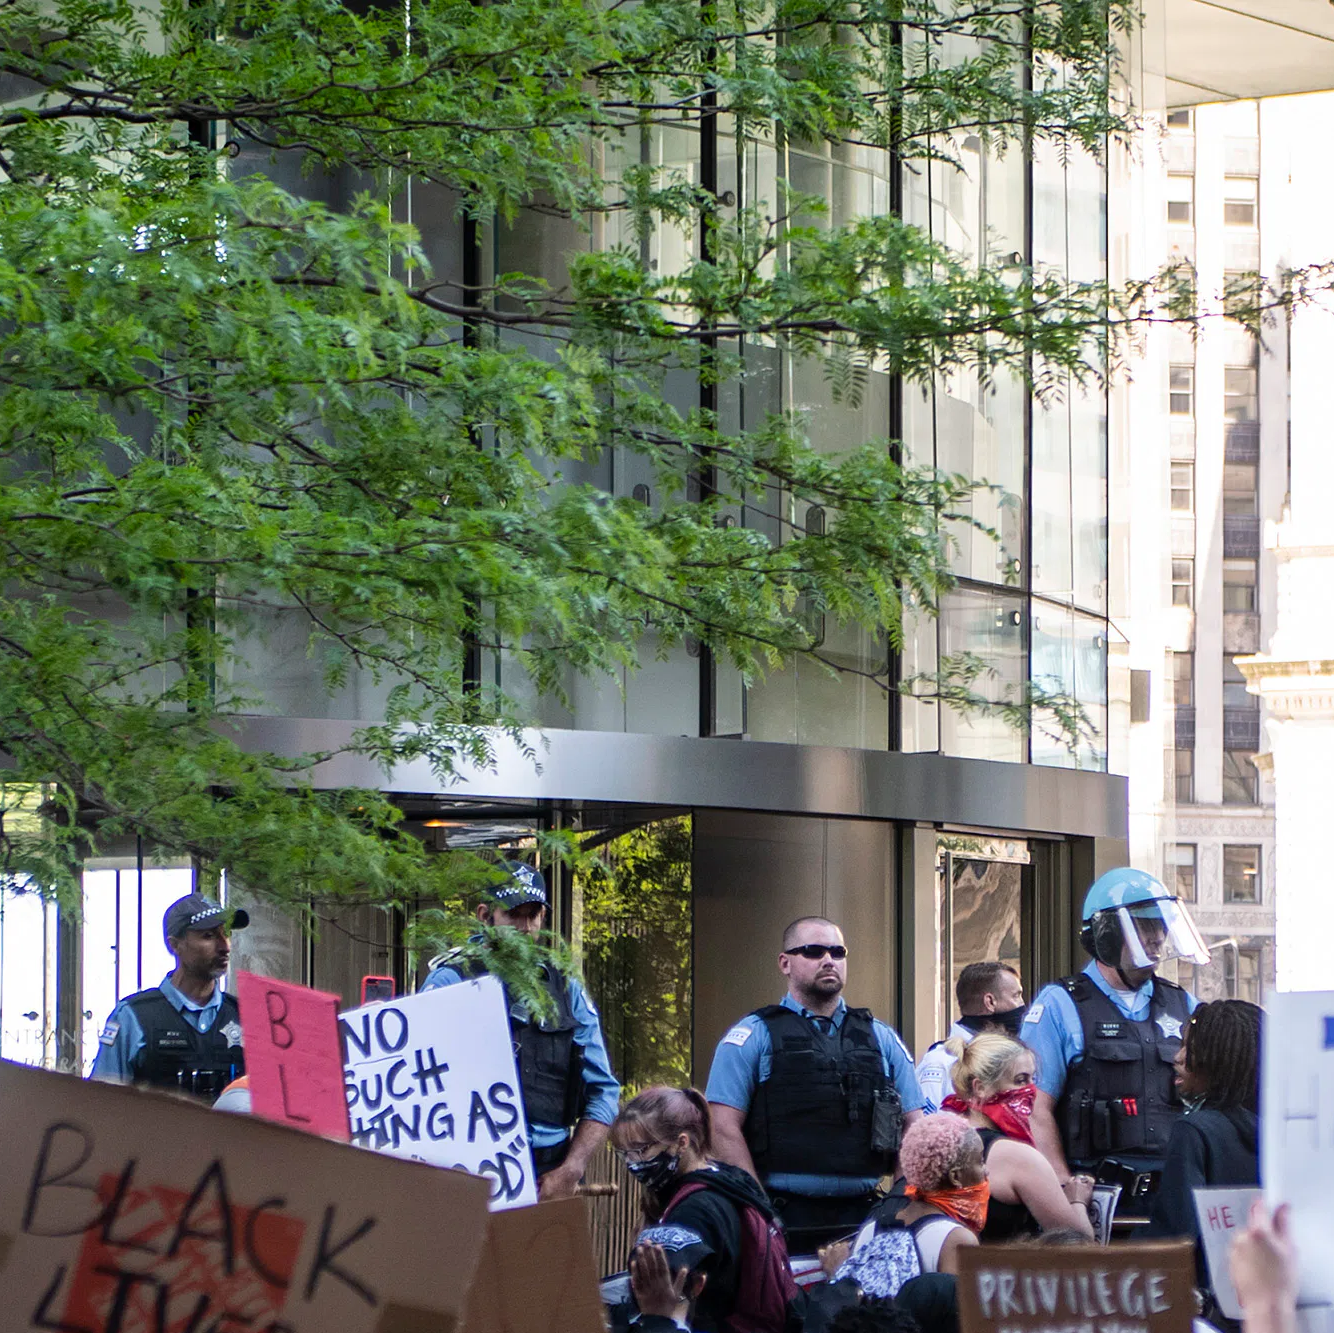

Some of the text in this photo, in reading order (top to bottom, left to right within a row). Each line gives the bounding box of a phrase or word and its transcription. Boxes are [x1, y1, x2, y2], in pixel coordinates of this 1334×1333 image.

[340, 1007, 409, 1059] NO
[345, 1047, 450, 1112] SUCH
[351, 1081, 520, 1150] HING AS
[21, 1120, 378, 1307] BLACK
[977, 1268, 1173, 1320] PRIVILEGE
